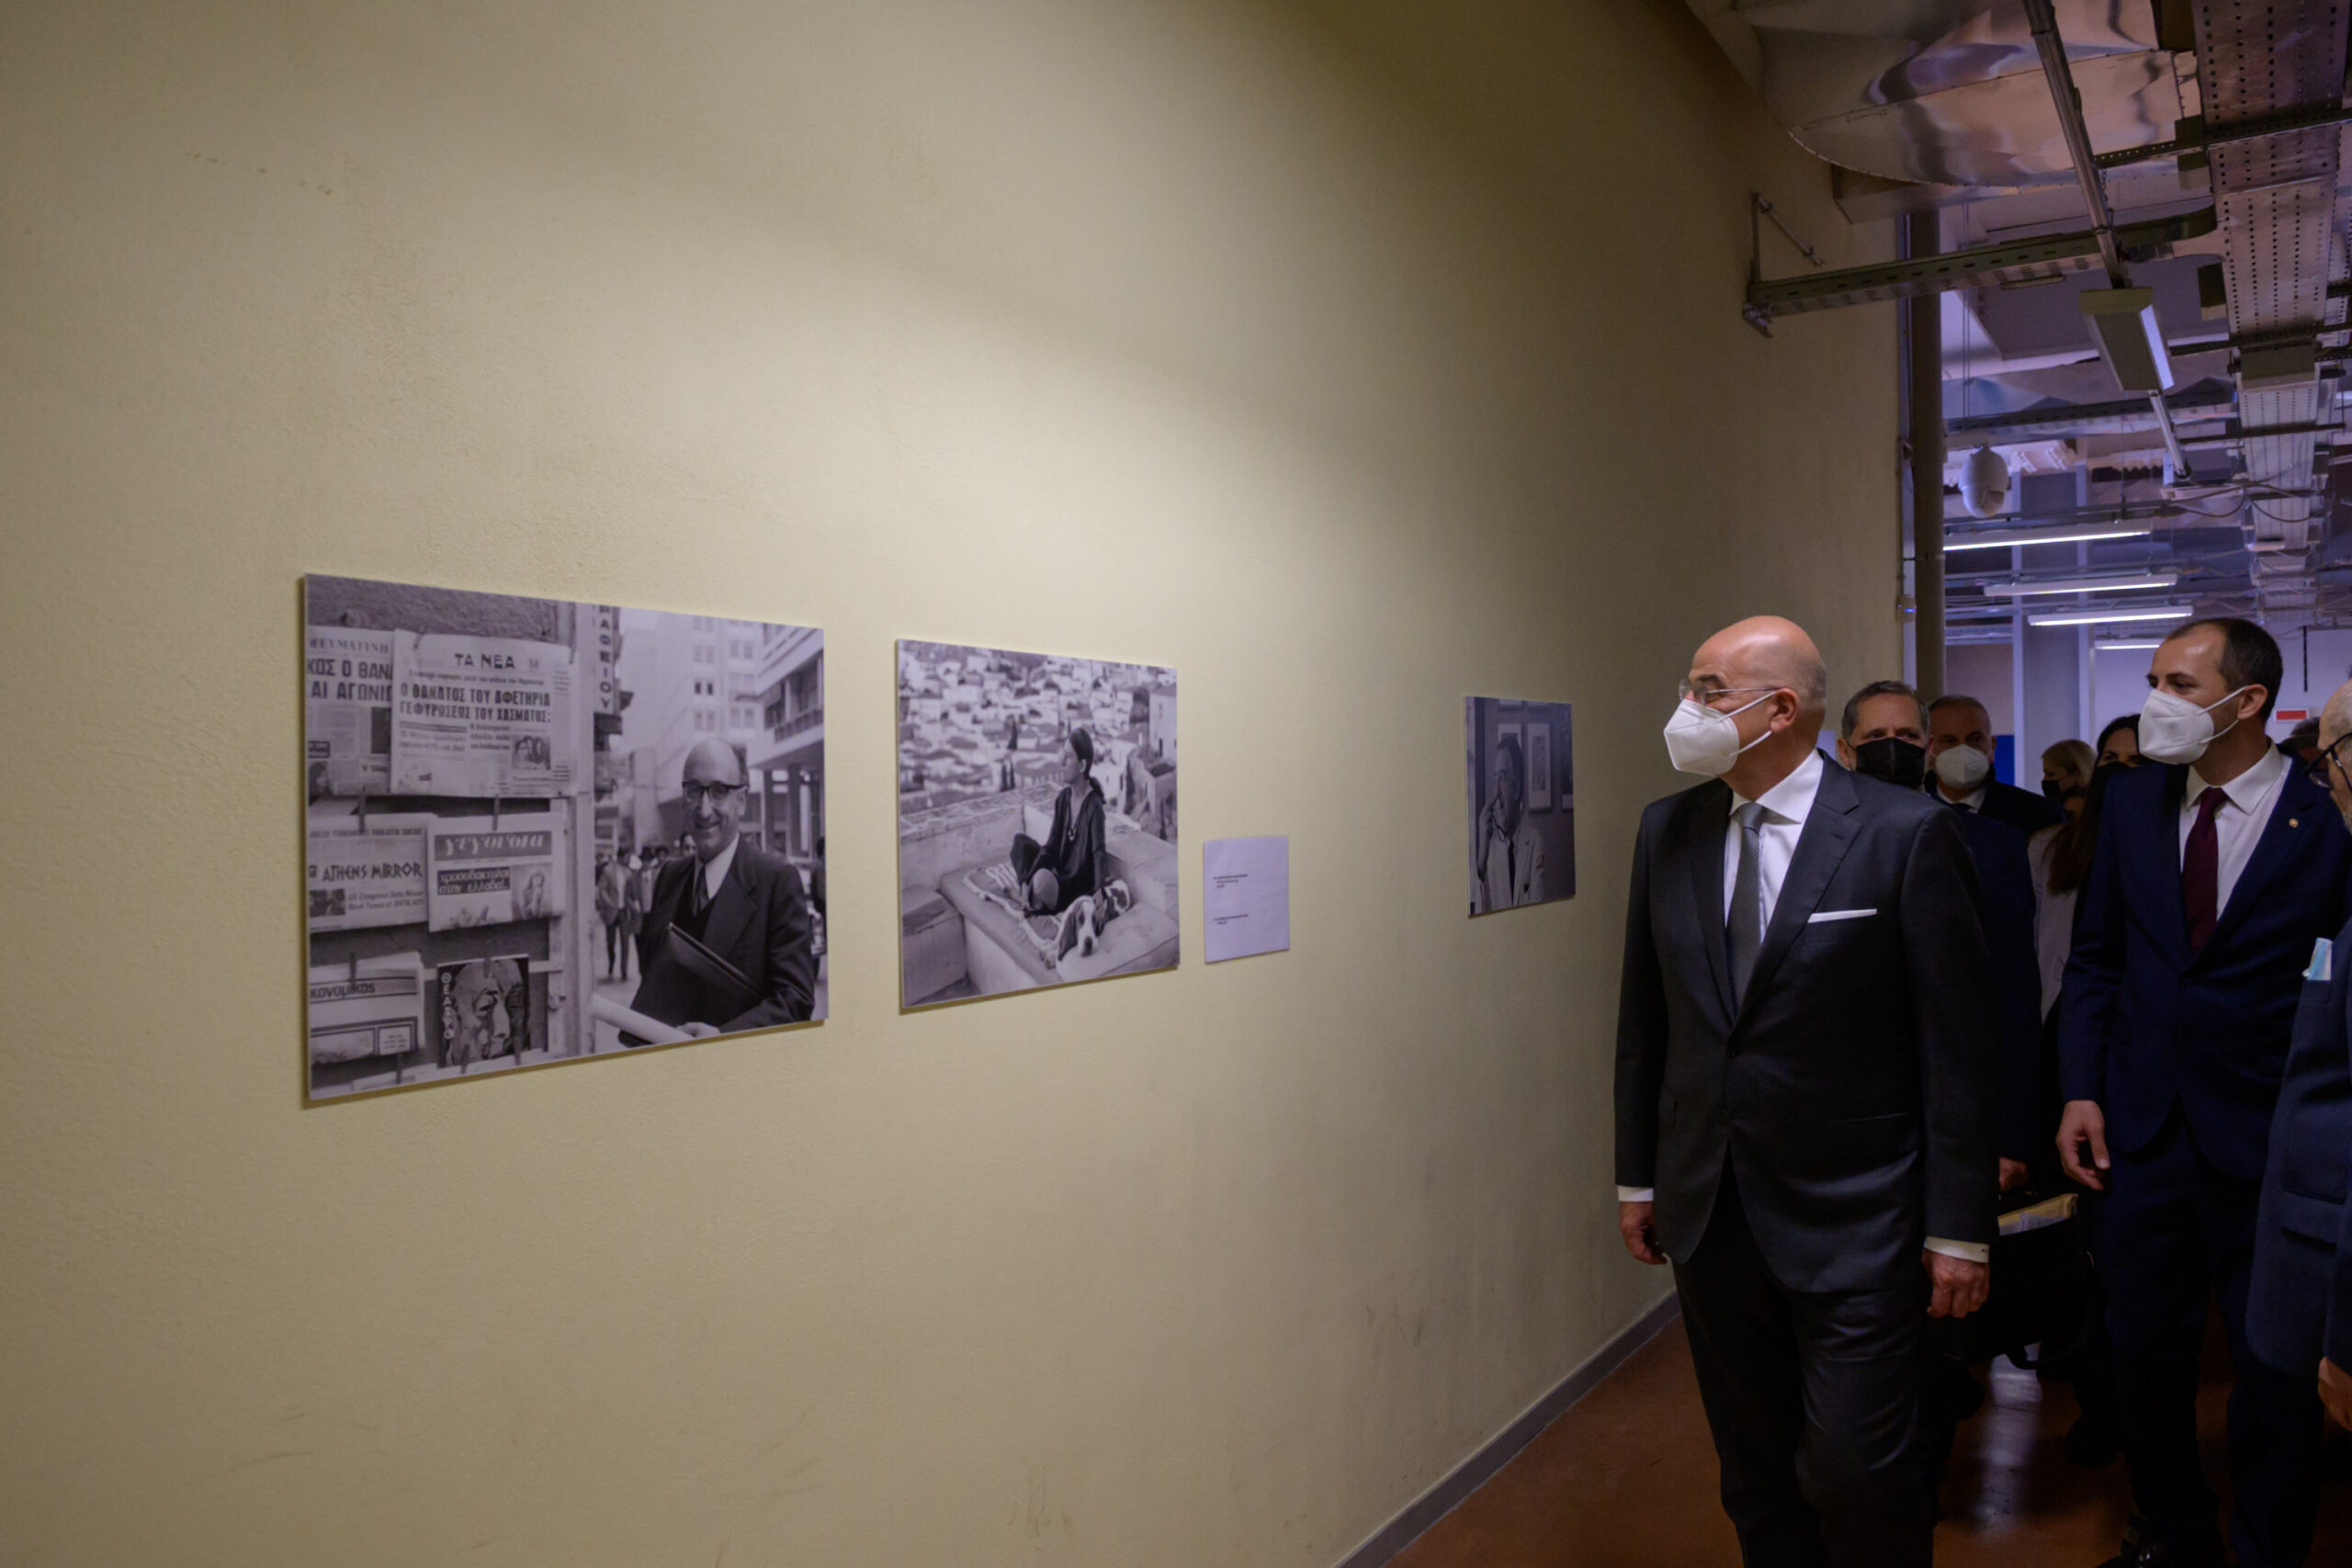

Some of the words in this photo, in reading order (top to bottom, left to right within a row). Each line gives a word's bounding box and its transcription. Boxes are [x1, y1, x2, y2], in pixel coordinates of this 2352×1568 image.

[455, 653, 474, 668] ΤΑ
[481, 654, 515, 670] ΝΕΑ
[469, 688, 491, 704] ΤΟΥ
[474, 706, 493, 720] ΤΟΥ
[322, 863, 368, 882] ATHENS
[370, 862, 424, 879] MIRROR
